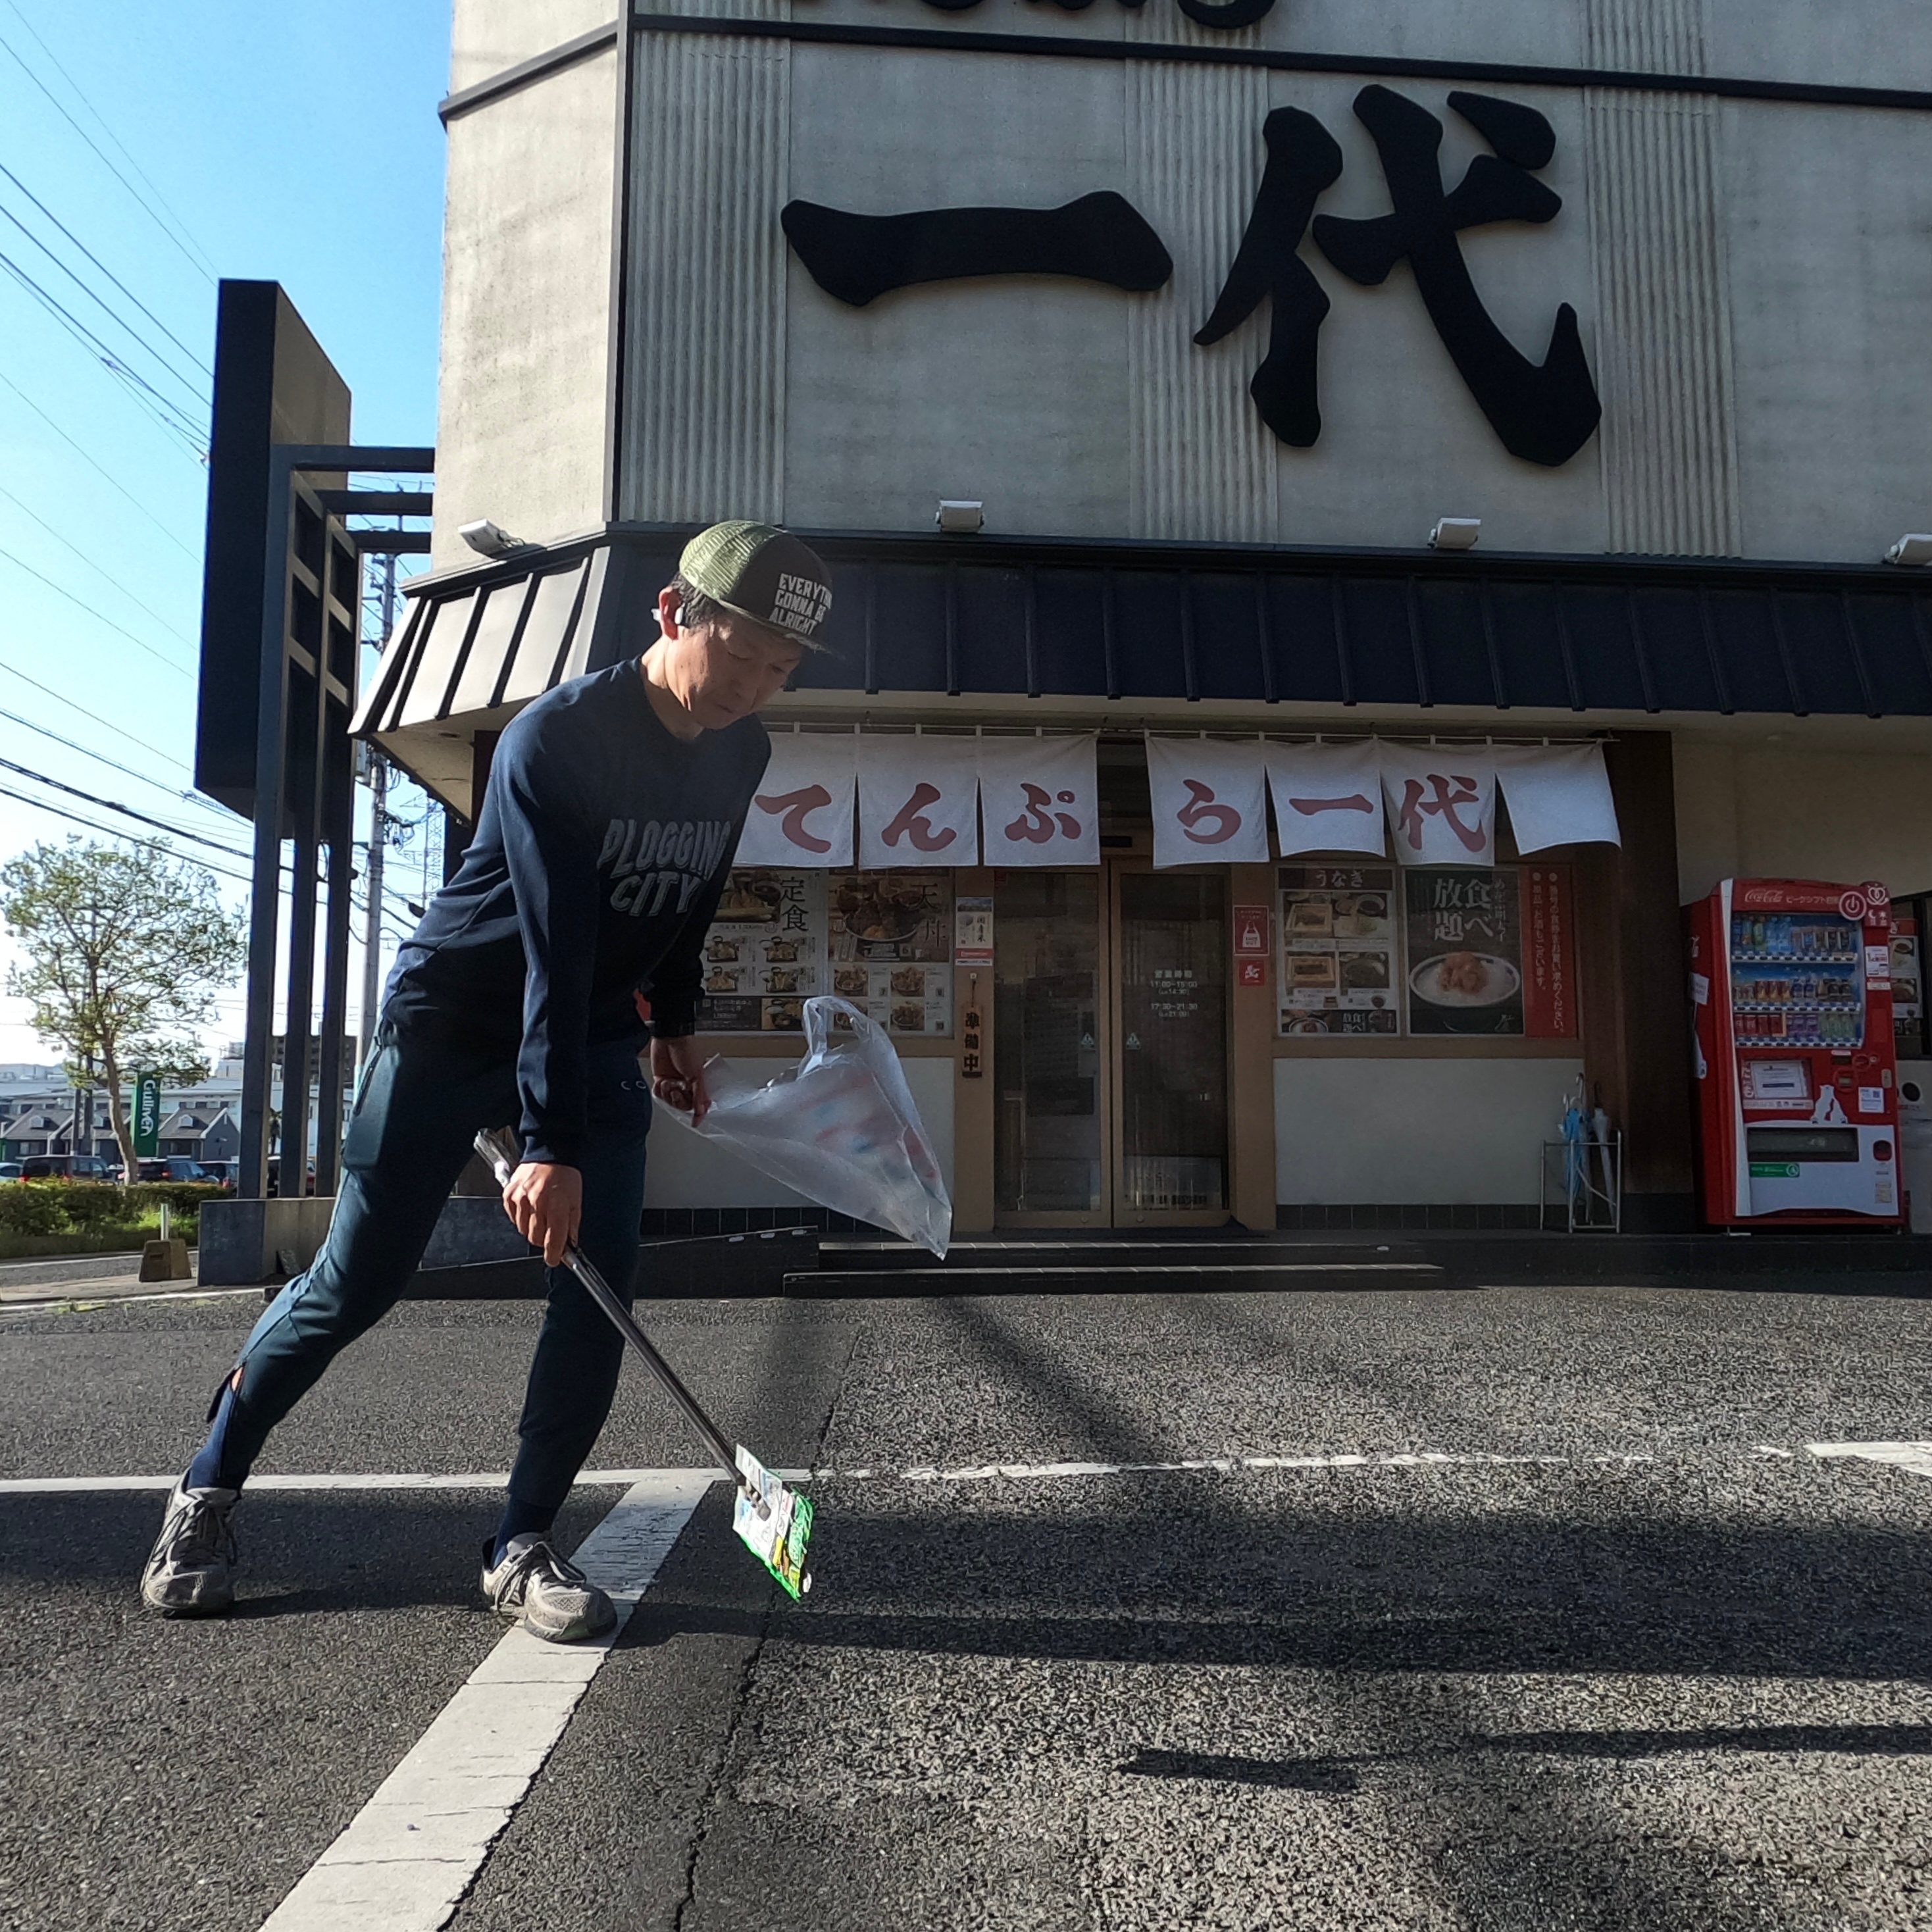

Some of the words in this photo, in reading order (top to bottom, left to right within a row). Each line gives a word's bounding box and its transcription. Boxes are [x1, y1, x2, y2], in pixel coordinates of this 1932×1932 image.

[781, 84, 1601, 467] 一代
[769, 607, 817, 635] ALRIGHT
[775, 589, 815, 617] GONNA
[596, 819, 732, 882] PLOGGIN
[1315, 869, 1365, 888] うなぎ
[609, 871, 702, 918] CITY
[780, 876, 809, 932] 定食
[910, 883, 946, 948] 天丼
[963, 1011, 980, 1071] 準備中
